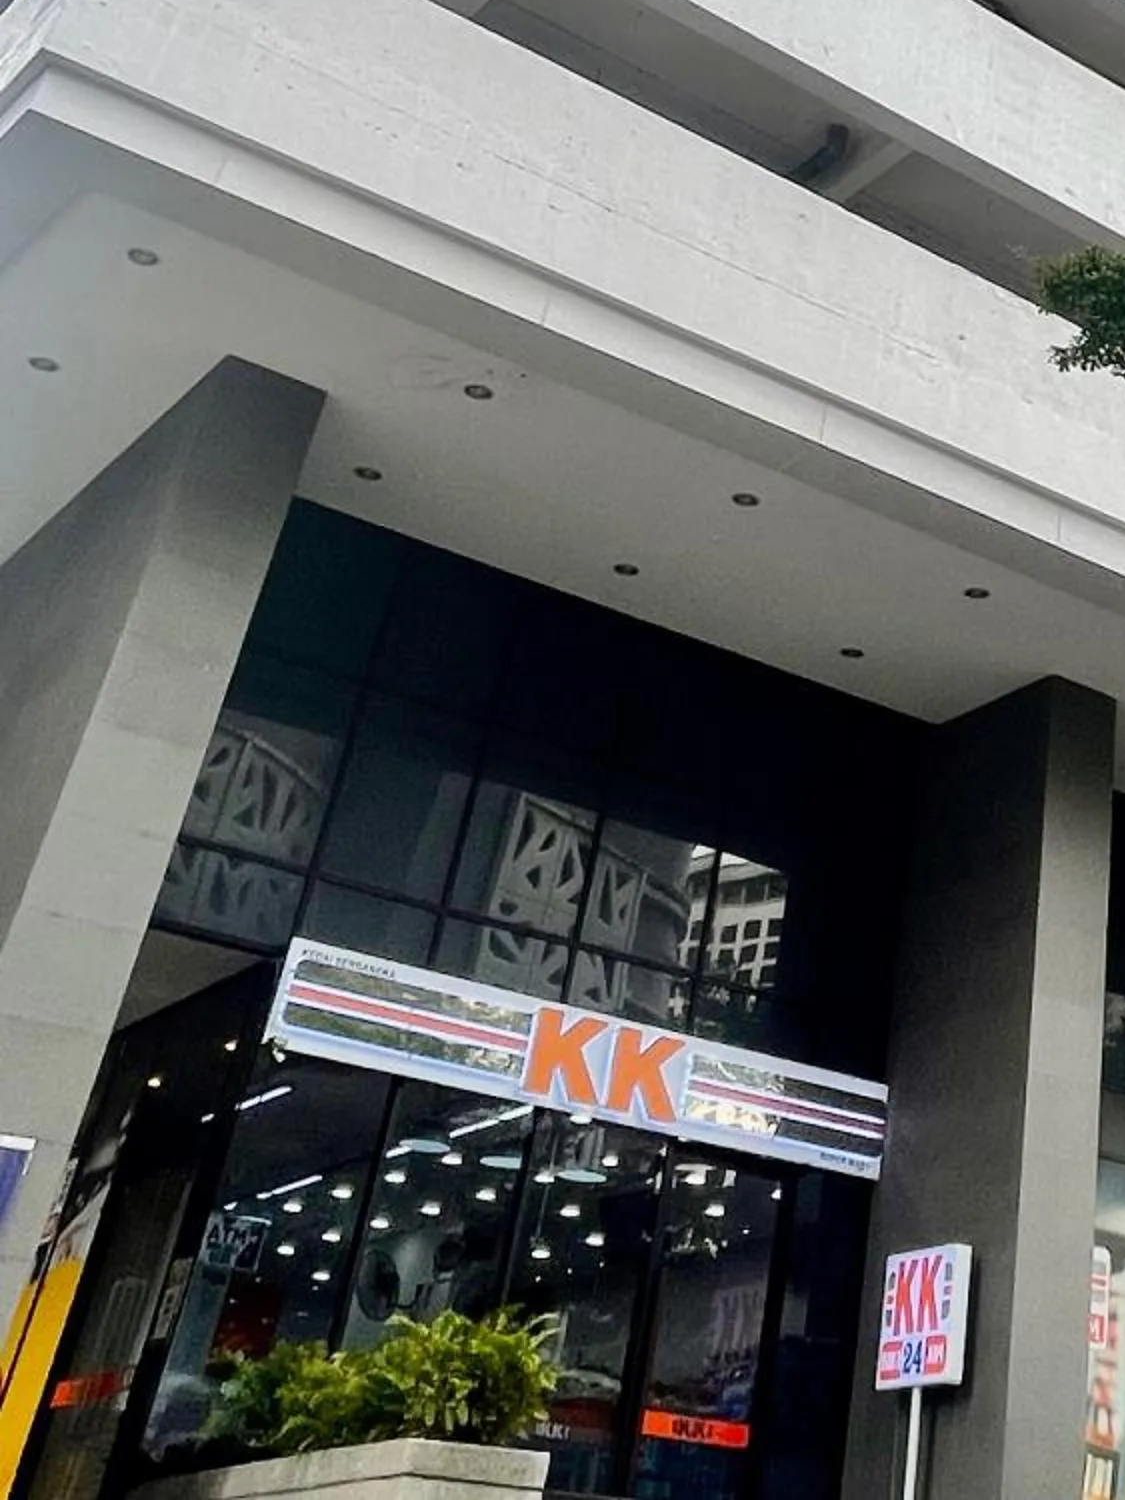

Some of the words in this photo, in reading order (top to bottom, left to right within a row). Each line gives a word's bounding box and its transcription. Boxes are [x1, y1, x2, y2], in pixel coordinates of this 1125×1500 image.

[524, 1008, 684, 1122] KK
[893, 1255, 943, 1336] KK
[903, 1339, 923, 1374] 24
